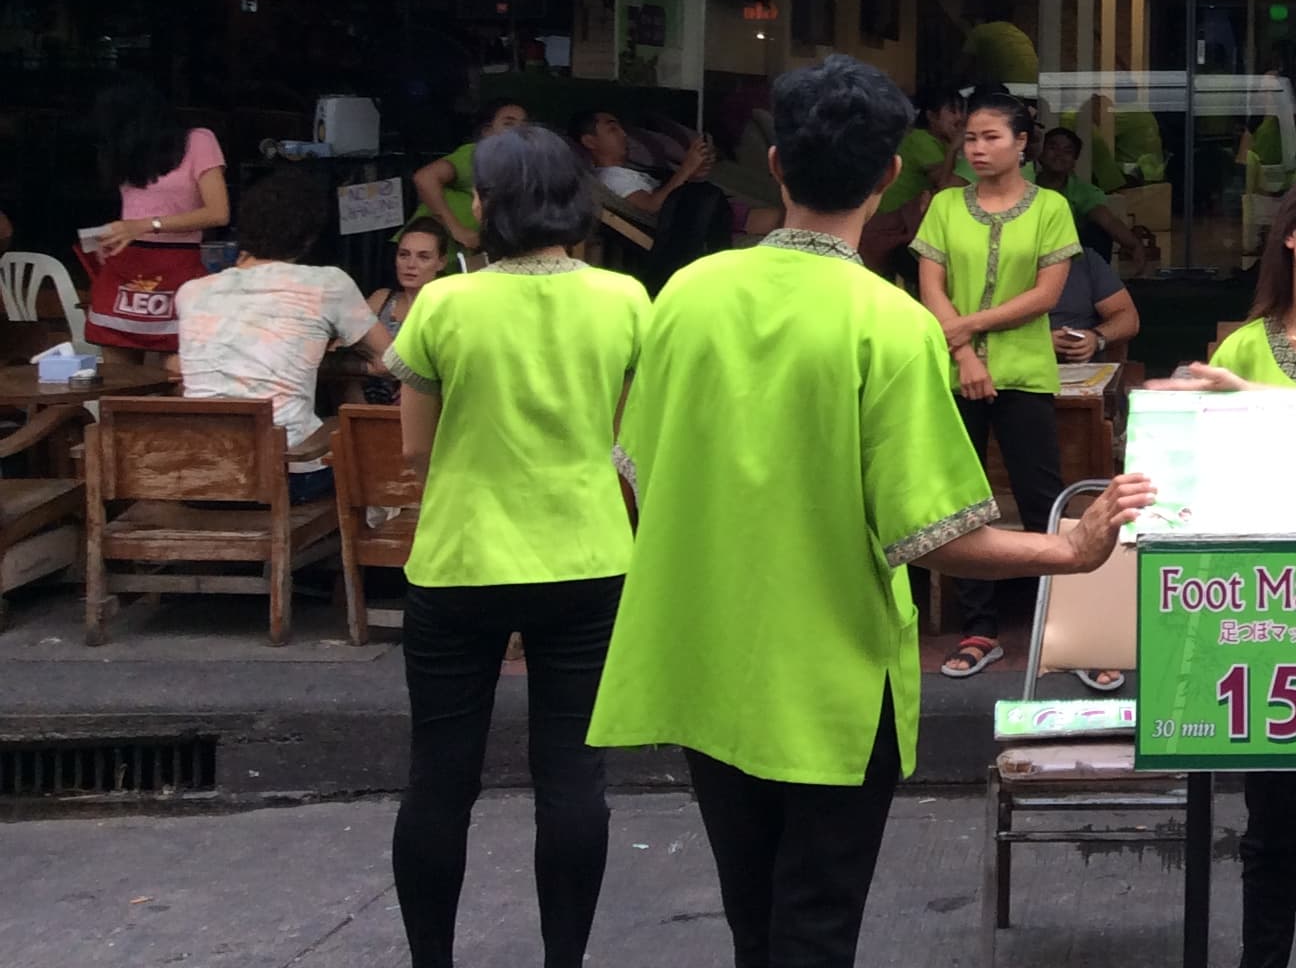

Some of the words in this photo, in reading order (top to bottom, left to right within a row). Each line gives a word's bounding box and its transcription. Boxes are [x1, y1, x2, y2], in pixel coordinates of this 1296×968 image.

[119, 291, 168, 316] LEO
[1159, 566, 1244, 614] Foot
[1152, 719, 1175, 738] 30
[1182, 719, 1217, 738] min
